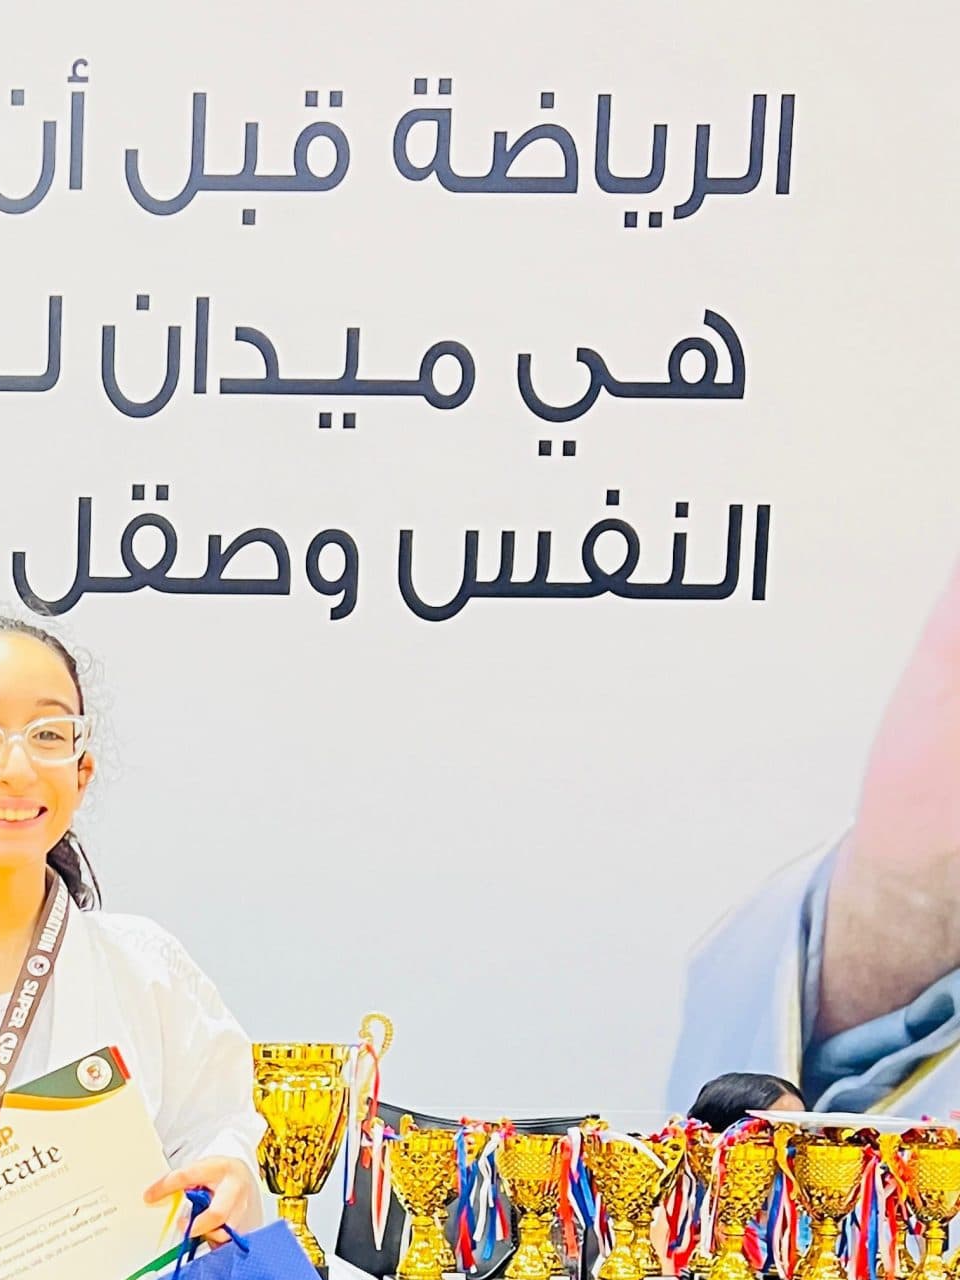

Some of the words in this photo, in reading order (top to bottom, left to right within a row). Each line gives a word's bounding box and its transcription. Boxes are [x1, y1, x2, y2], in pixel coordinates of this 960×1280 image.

[125, 90, 351, 226] قبل
[393, 78, 796, 229] الرياضة
[101, 293, 476, 430] ميدان
[516, 308, 746, 457] هي
[11, 483, 360, 622] وصقل
[397, 488, 772, 623] النفس
[7, 978, 39, 1030] SUPER
